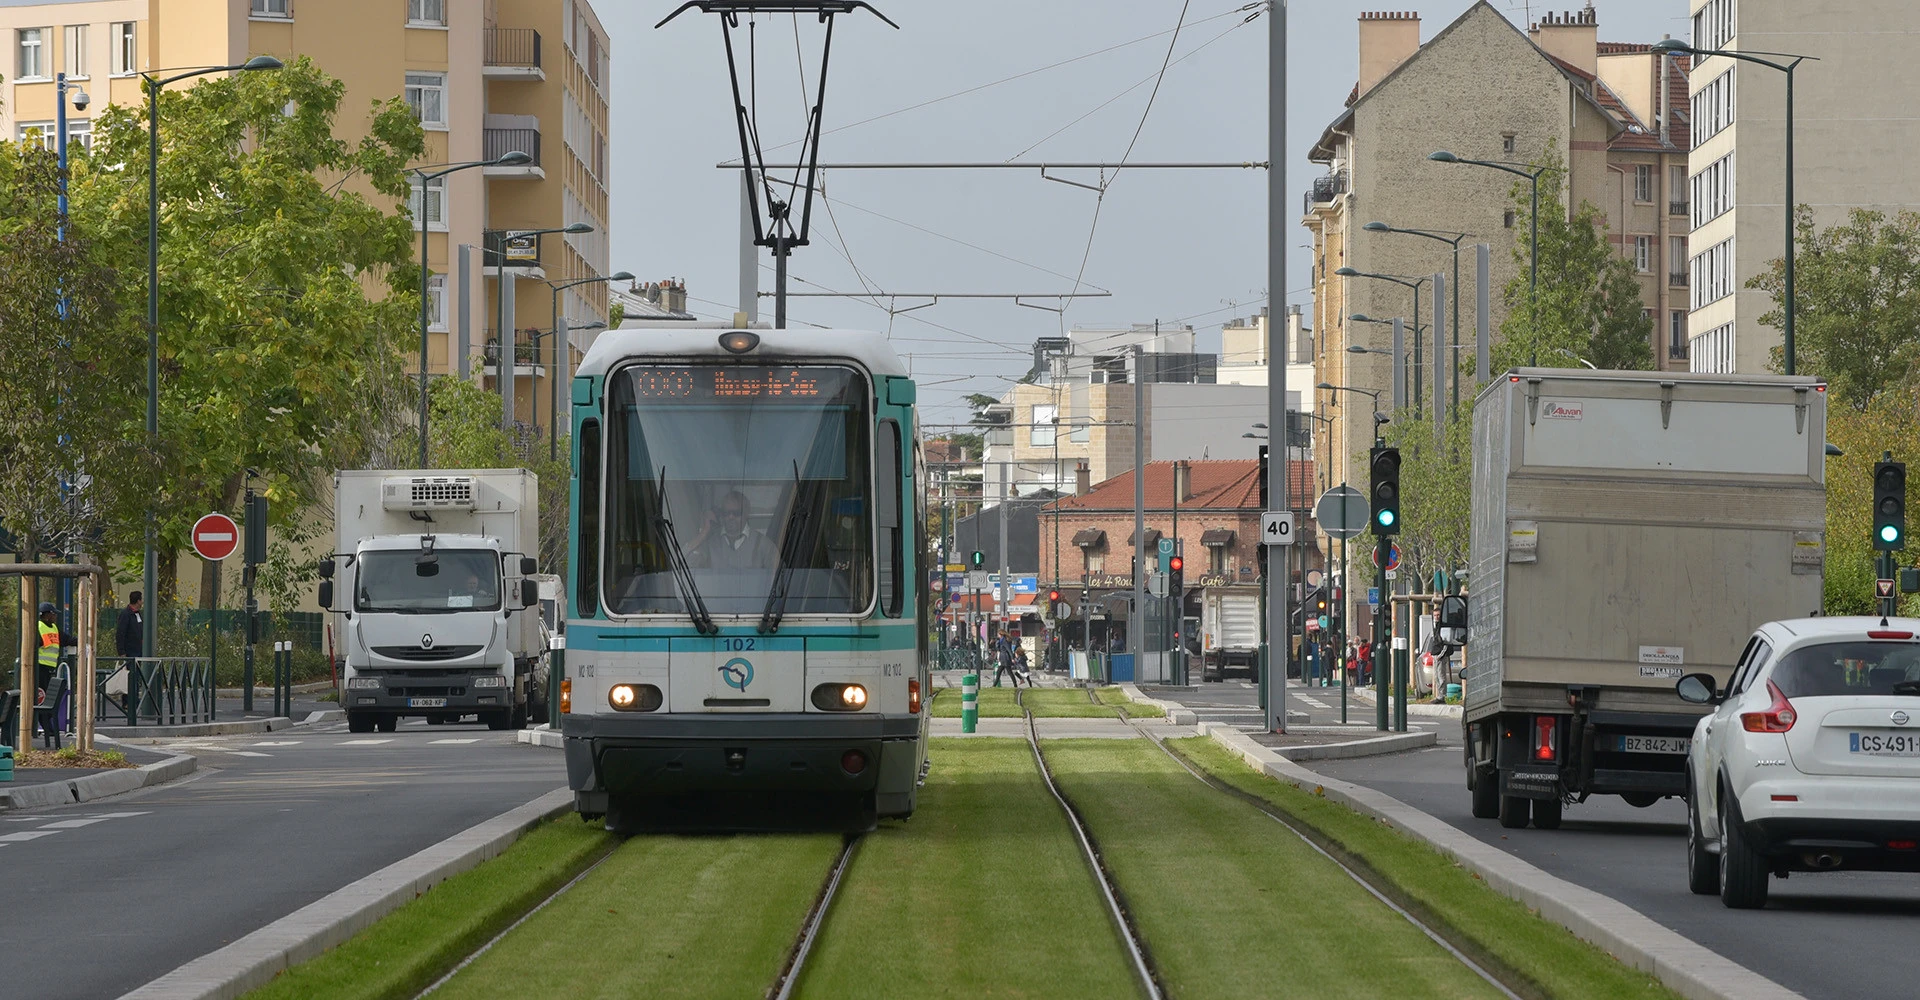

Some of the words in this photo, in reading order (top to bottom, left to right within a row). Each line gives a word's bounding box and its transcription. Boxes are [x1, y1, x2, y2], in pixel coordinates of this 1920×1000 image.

[1267, 521, 1289, 535] 40
[1104, 575, 1113, 587] 4
[723, 638, 755, 651] 102
[1862, 736, 1920, 751] CS-491-
[1755, 759, 1786, 767] JUKE
